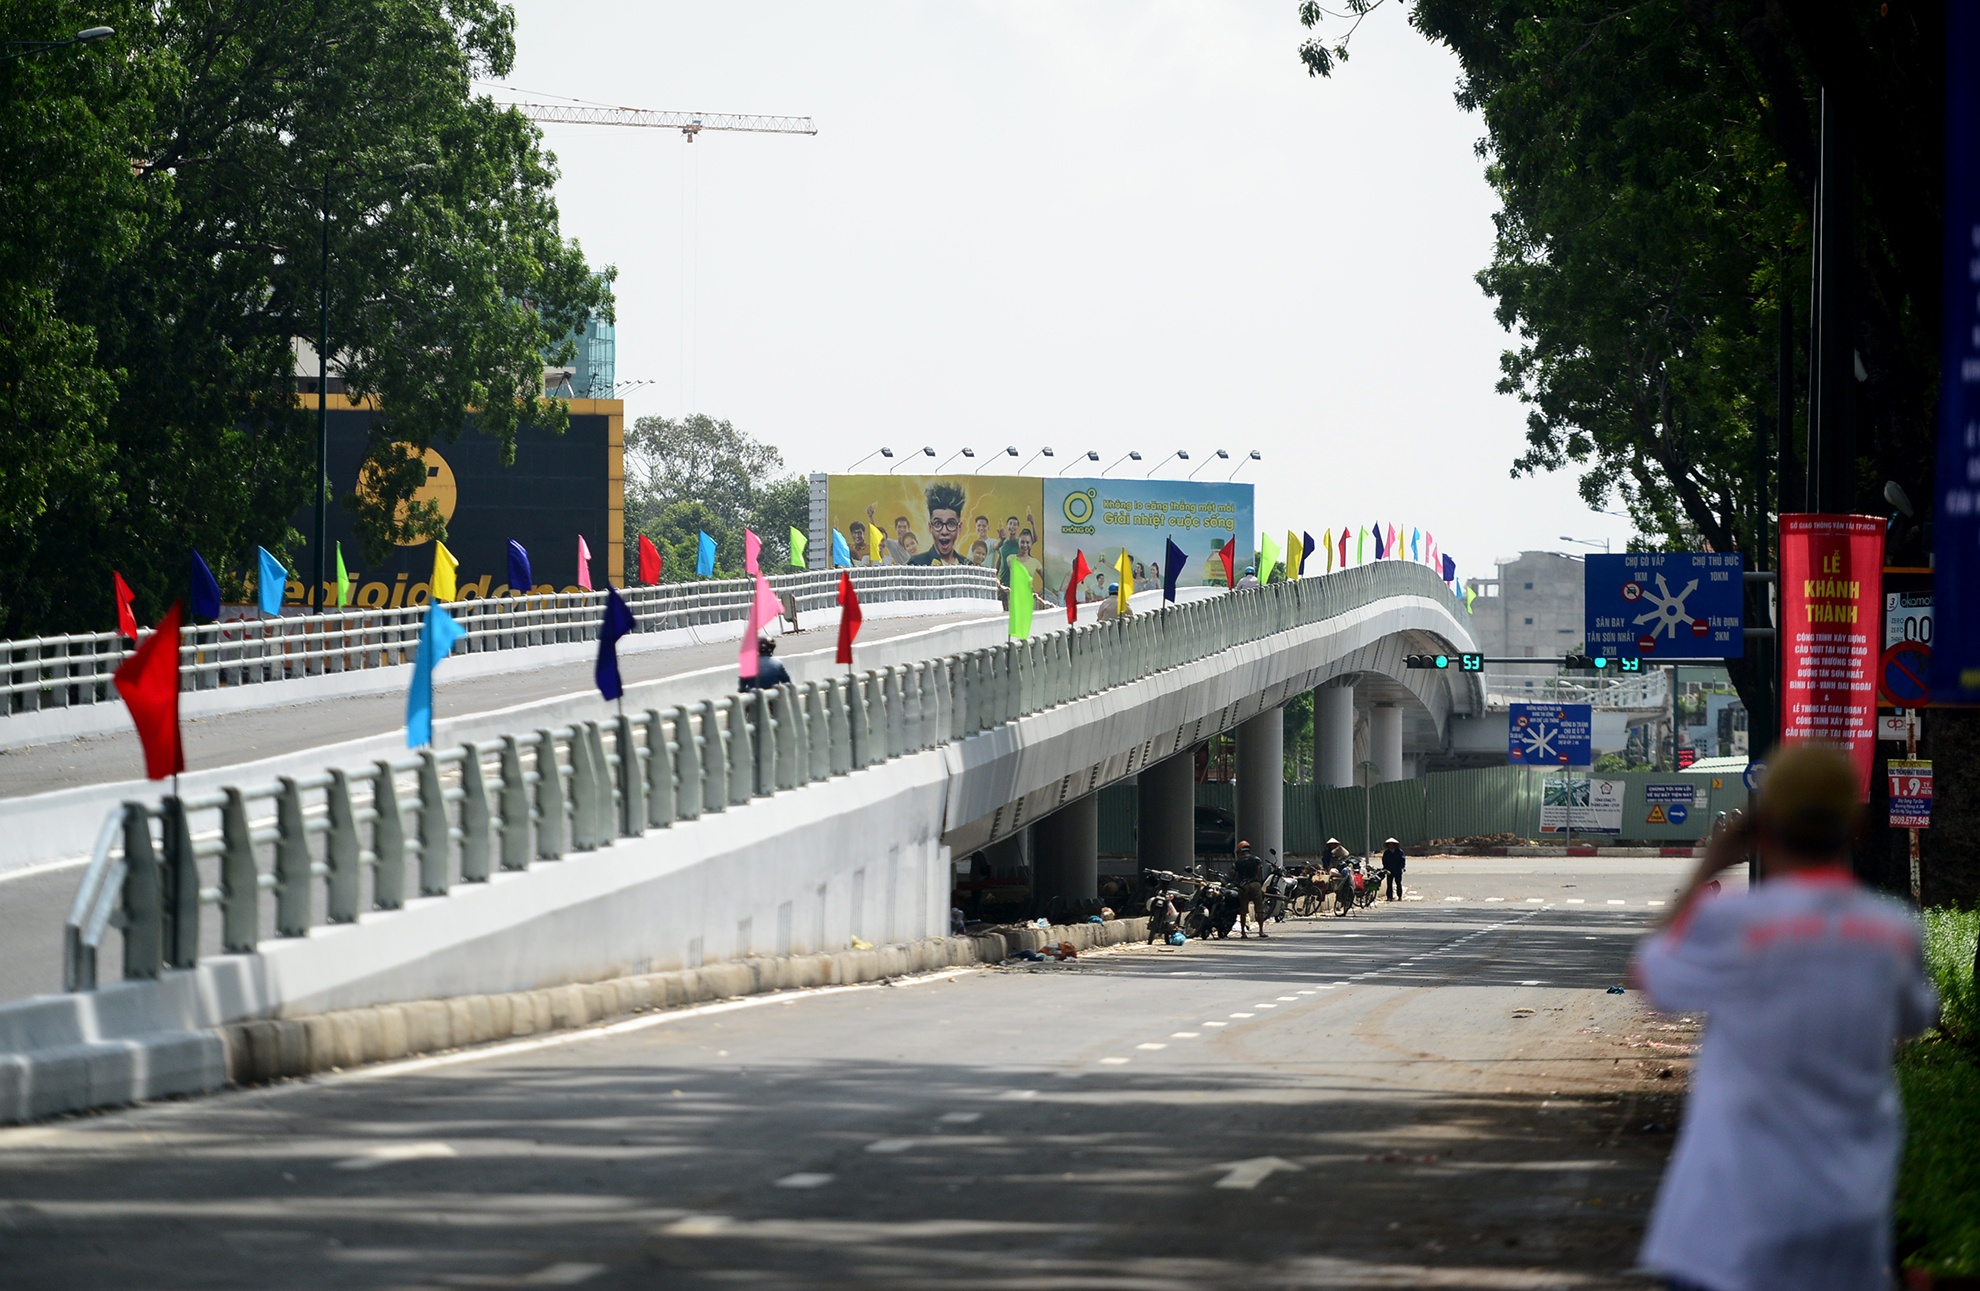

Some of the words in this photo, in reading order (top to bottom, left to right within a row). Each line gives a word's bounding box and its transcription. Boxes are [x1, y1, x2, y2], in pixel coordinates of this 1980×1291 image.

[1104, 500, 1132, 511] Không
[1134, 501, 1143, 510] lo
[1146, 502, 1168, 511] căng
[1171, 500, 1196, 513] thẳng
[1199, 502, 1215, 514] mệt
[1218, 502, 1235, 512] mỏi
[1104, 512, 1130, 524] Giải
[1133, 513, 1165, 529] nhiệt
[1168, 515, 1199, 530] cuộc
[1204, 514, 1235, 531] sống
[1846, 522, 1854, 530] TẢI
[1062, 524, 1084, 534] KHÔNG
[1085, 525, 1095, 535] ĐỘ
[1625, 556, 1639, 568] CHỢ
[1640, 555, 1649, 566] GÒ
[1652, 555, 1665, 566] VẤP
[1692, 556, 1706, 568] CHỢ
[1708, 553, 1721, 566] THỦ
[1724, 555, 1739, 566] ĐỨC
[1823, 550, 1840, 573] LỄ
[1634, 572, 1647, 582] 1KM
[1710, 572, 1728, 581] 10KM
[1804, 576, 1860, 599] KHÁNH
[1890, 598, 1895, 606] 3
[1805, 601, 1858, 624] THÀNH
[1596, 616, 1610, 627] SÂN
[1612, 618, 1625, 627] BAY
[1708, 615, 1722, 627] TÂN
[1723, 617, 1739, 628] ĐỊNH
[1587, 630, 1601, 642] TÂN
[1602, 632, 1616, 642] SƠN
[1618, 629, 1635, 642] NHẤT
[1797, 632, 1814, 642] CÔNG
[1816, 632, 1832, 642] TRÌNH
[1834, 633, 1846, 642] XÂY
[1848, 634, 1866, 644] DỰNG
[1602, 646, 1616, 656] 2KM
[1795, 643, 1808, 653] CẦU
[1825, 646, 1835, 655] TẠI
[1837, 645, 1849, 654] NÚT
[1851, 647, 1867, 655] GIAO
[1822, 657, 1846, 666] TRƯỜNG
[1848, 658, 1861, 667] SƠN
[1819, 669, 1829, 677] TÂN
[1831, 670, 1844, 678] SƠN
[1846, 668, 1864, 679] NHẤT
[1790, 680, 1806, 689] BÌNH
[1820, 680, 1836, 689] VÀNH
[1850, 682, 1871, 690] NGOÀI
[1793, 702, 1800, 712] LỄ
[1801, 704, 1819, 713] THÔNG
[1844, 706, 1862, 715] ĐOẠN
[1796, 716, 1812, 724] CÔNG
[1813, 716, 1828, 725] TRÌNH
[1830, 716, 1844, 725] XÂY
[1845, 717, 1863, 727] DỰNG
[1786, 726, 1798, 736] CẦU
[1816, 727, 1828, 736] THÉP
[1831, 729, 1840, 739] TẠI
[1843, 729, 1856, 738] NÚT
[1892, 778, 1920, 796] 1.9
